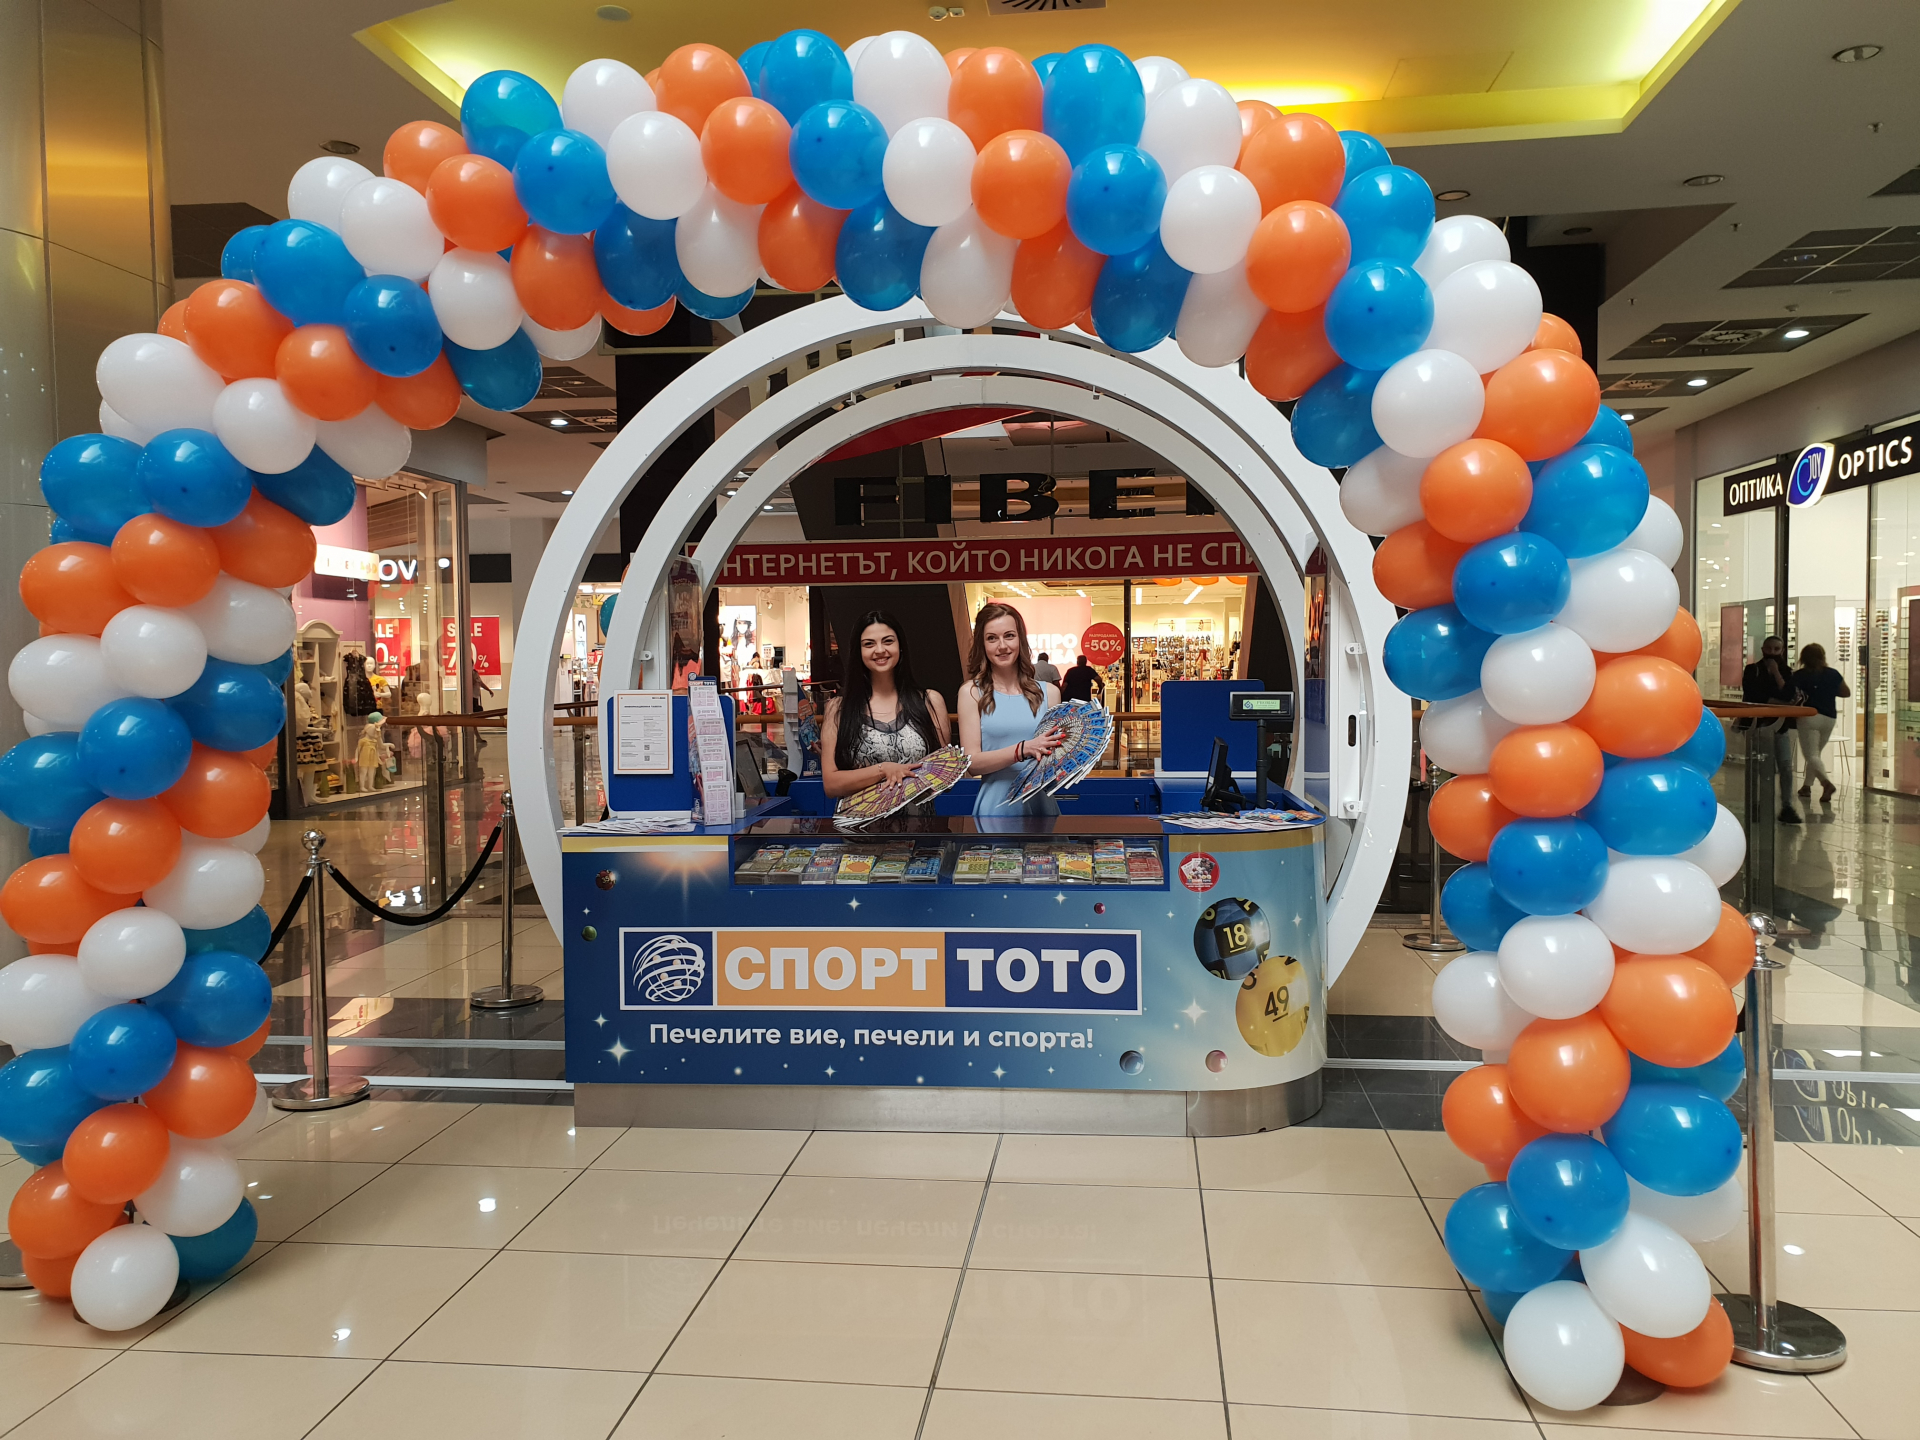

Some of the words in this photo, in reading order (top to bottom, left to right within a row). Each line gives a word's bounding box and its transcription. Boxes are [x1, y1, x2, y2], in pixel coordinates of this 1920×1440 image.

[1838, 435, 1913, 480] OPTICS
[1729, 472, 1784, 506] ОПТИКА
[723, 551, 898, 580] НТЕРНЕТЪТ,
[908, 541, 1010, 575] КОЙТО
[1020, 544, 1144, 572] НИКОГА
[1153, 543, 1193, 568] НЕ
[1222, 923, 1248, 950] 18
[724, 946, 938, 991] СПОРТ
[956, 947, 1126, 995] ТОТО
[1264, 985, 1290, 1017] 49
[650, 1023, 782, 1044] Печелите
[789, 1028, 846, 1049] вие,
[854, 1028, 954, 1047] печели
[963, 1030, 980, 1047] и
[988, 1028, 1094, 1053] спорта!
